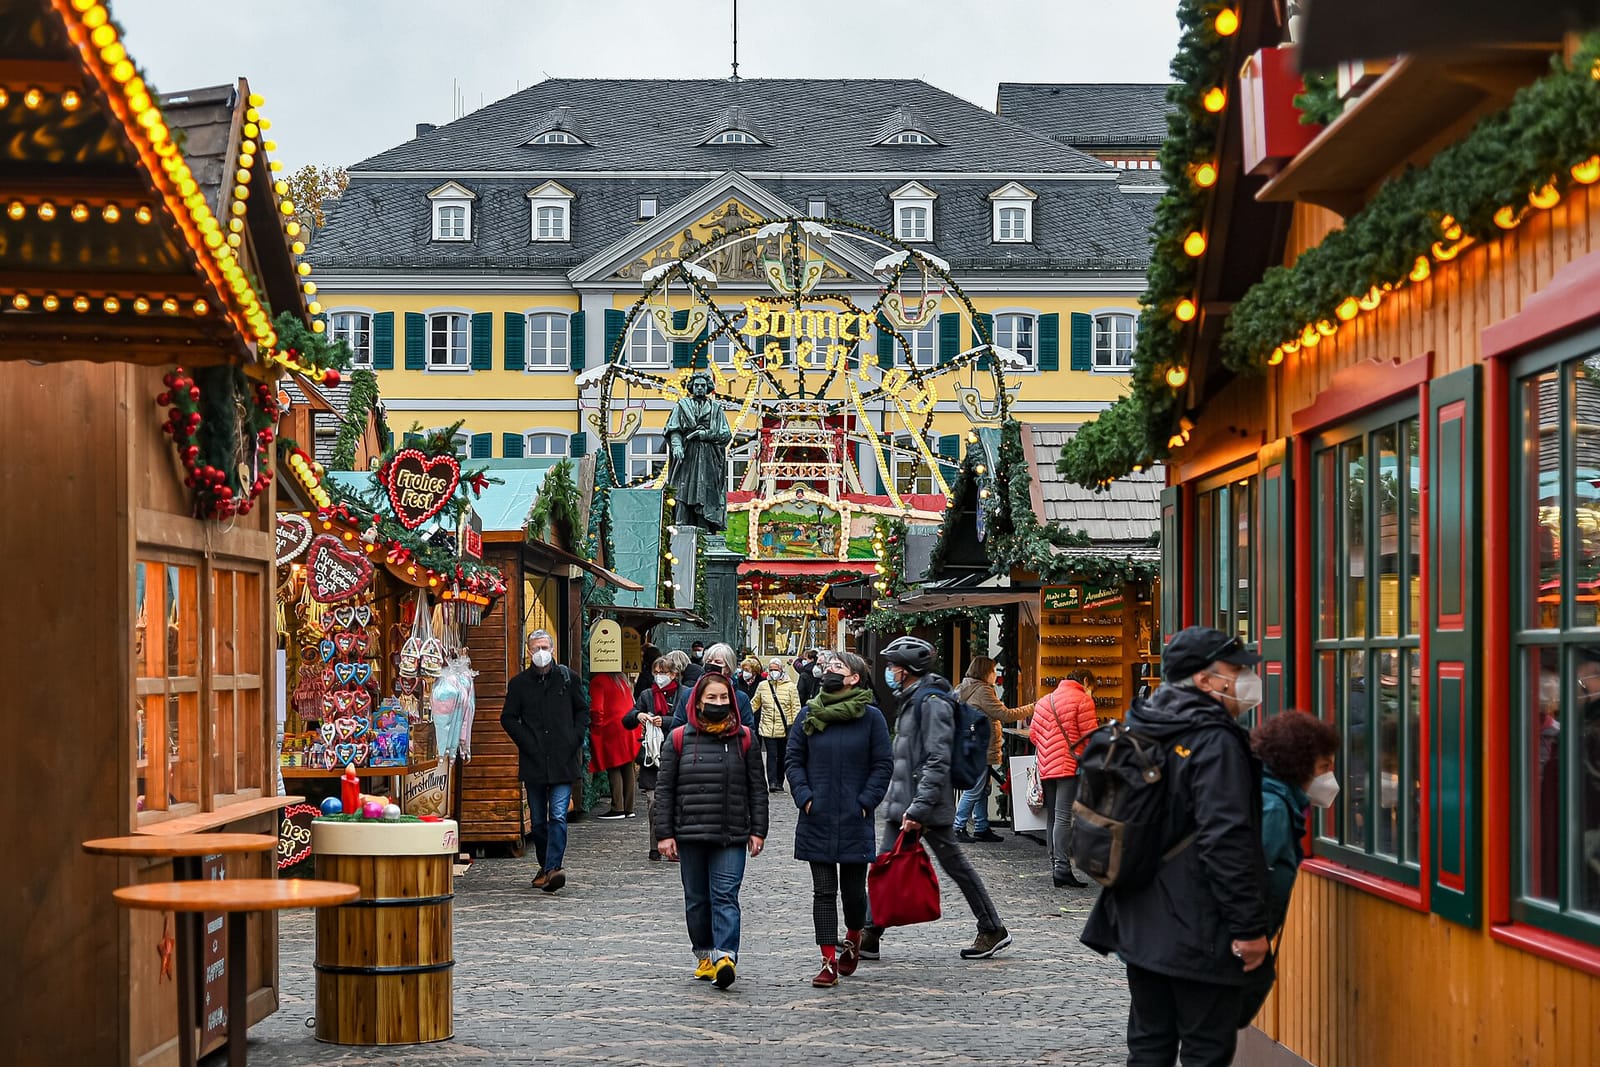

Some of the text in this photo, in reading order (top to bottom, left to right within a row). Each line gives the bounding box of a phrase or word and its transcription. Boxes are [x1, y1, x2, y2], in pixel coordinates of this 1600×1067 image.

[738, 298, 875, 342] Bonner
[396, 469, 447, 494] Frohes
[400, 489, 434, 511] Fest
[405, 772, 447, 801] Herstellung
